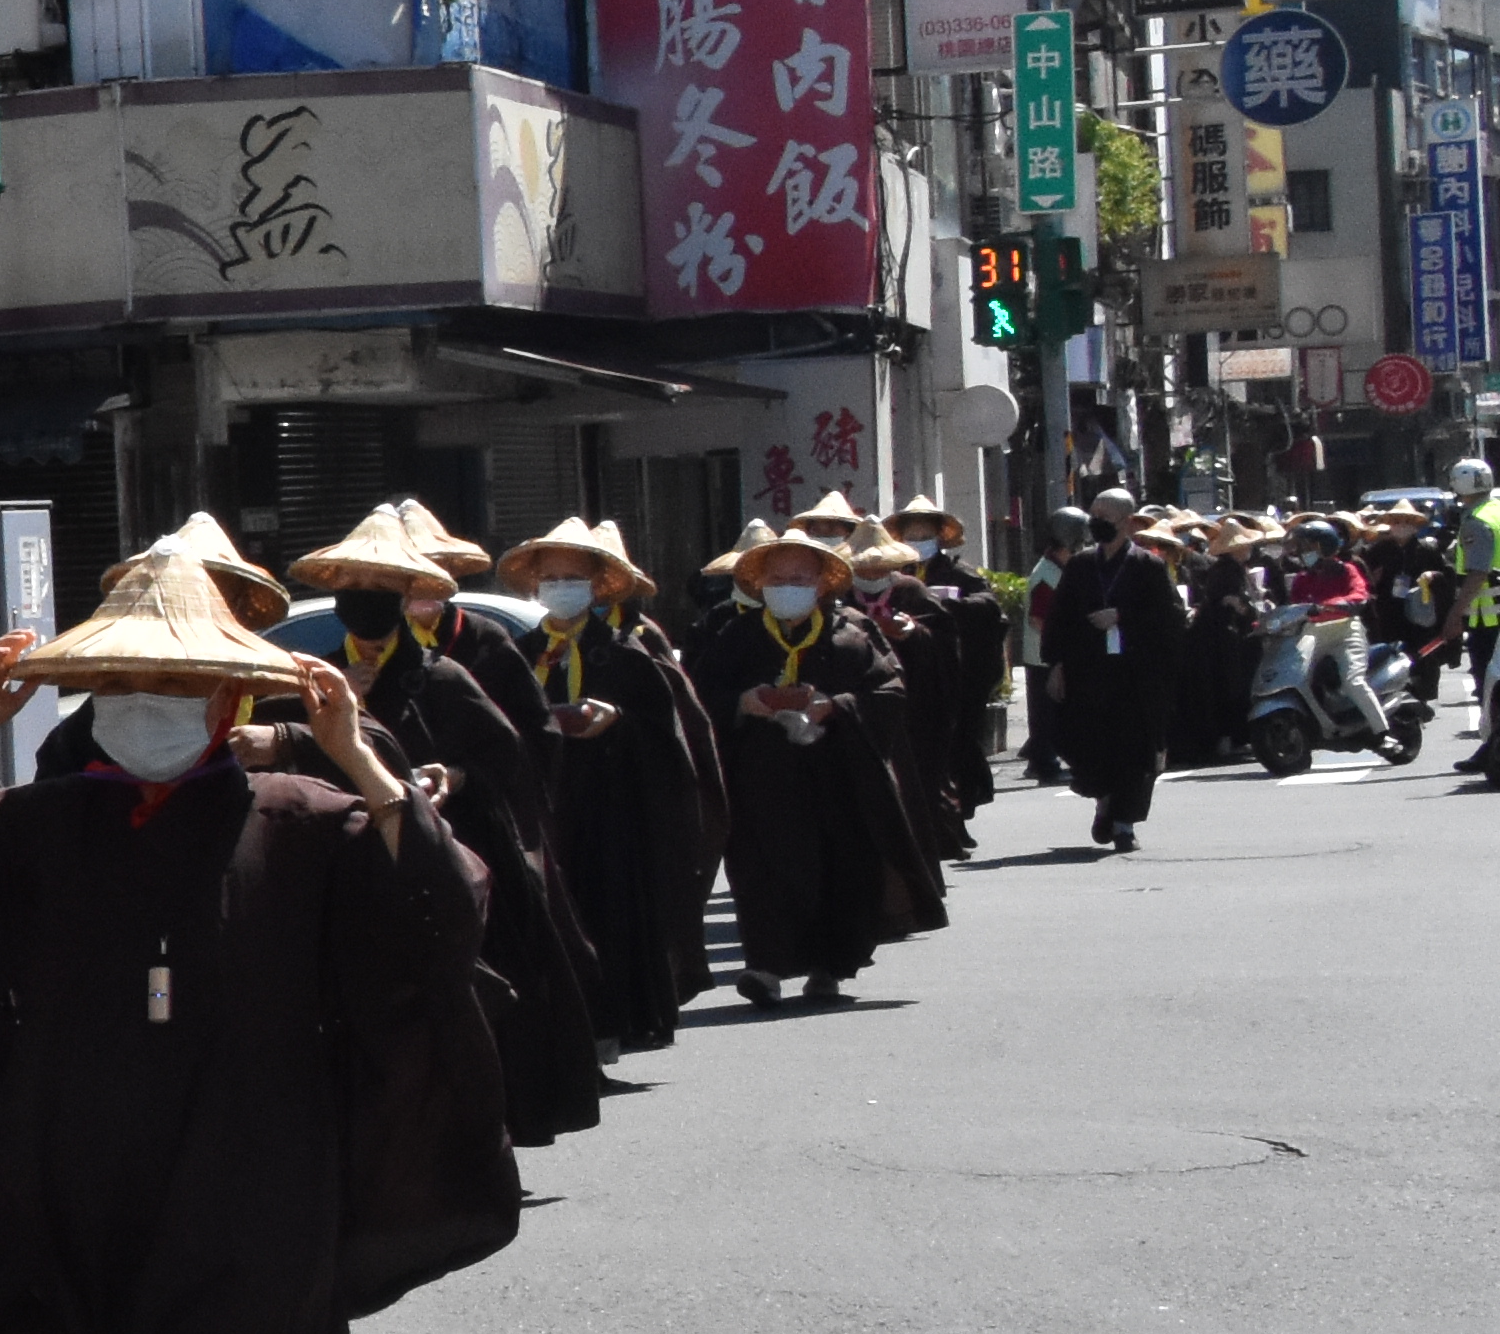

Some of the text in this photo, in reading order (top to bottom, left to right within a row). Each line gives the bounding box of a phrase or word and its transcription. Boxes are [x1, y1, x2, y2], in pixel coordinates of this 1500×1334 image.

[1243, 23, 1326, 109] 藥
[1026, 44, 1064, 180] 中山路
[980, 248, 1020, 288] 31
